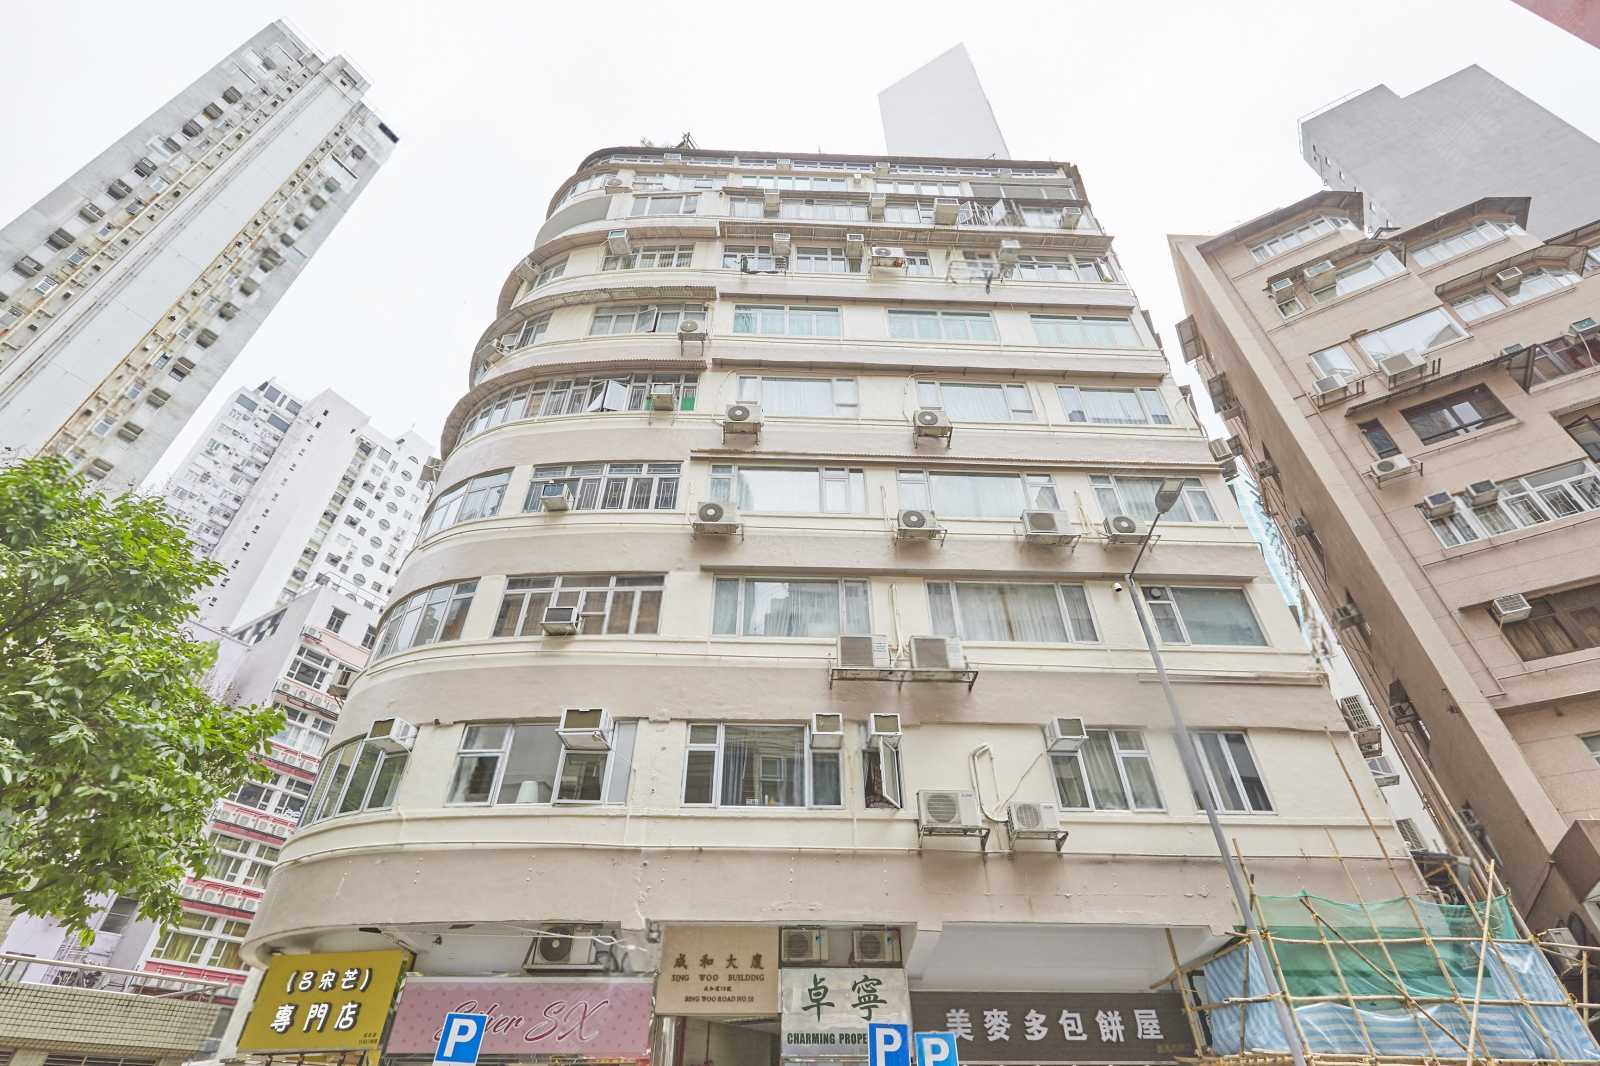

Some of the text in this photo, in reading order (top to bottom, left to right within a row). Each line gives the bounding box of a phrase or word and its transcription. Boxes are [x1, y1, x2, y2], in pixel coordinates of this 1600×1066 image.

[673, 952, 765, 970] 成和大廈
[698, 974, 719, 982] WOO
[727, 974, 765, 982] BUILDING
[802, 973, 888, 1023] 卓寧
[270, 1001, 359, 1032] 專門店
[524, 1001, 608, 1041] SX
[945, 1008, 1165, 1042] 美麥多包餅屋
[443, 1018, 478, 1058] P
[787, 1033, 868, 1045] CHARMING PROPE
[875, 1027, 902, 1066] P
[921, 1037, 949, 1066] P
